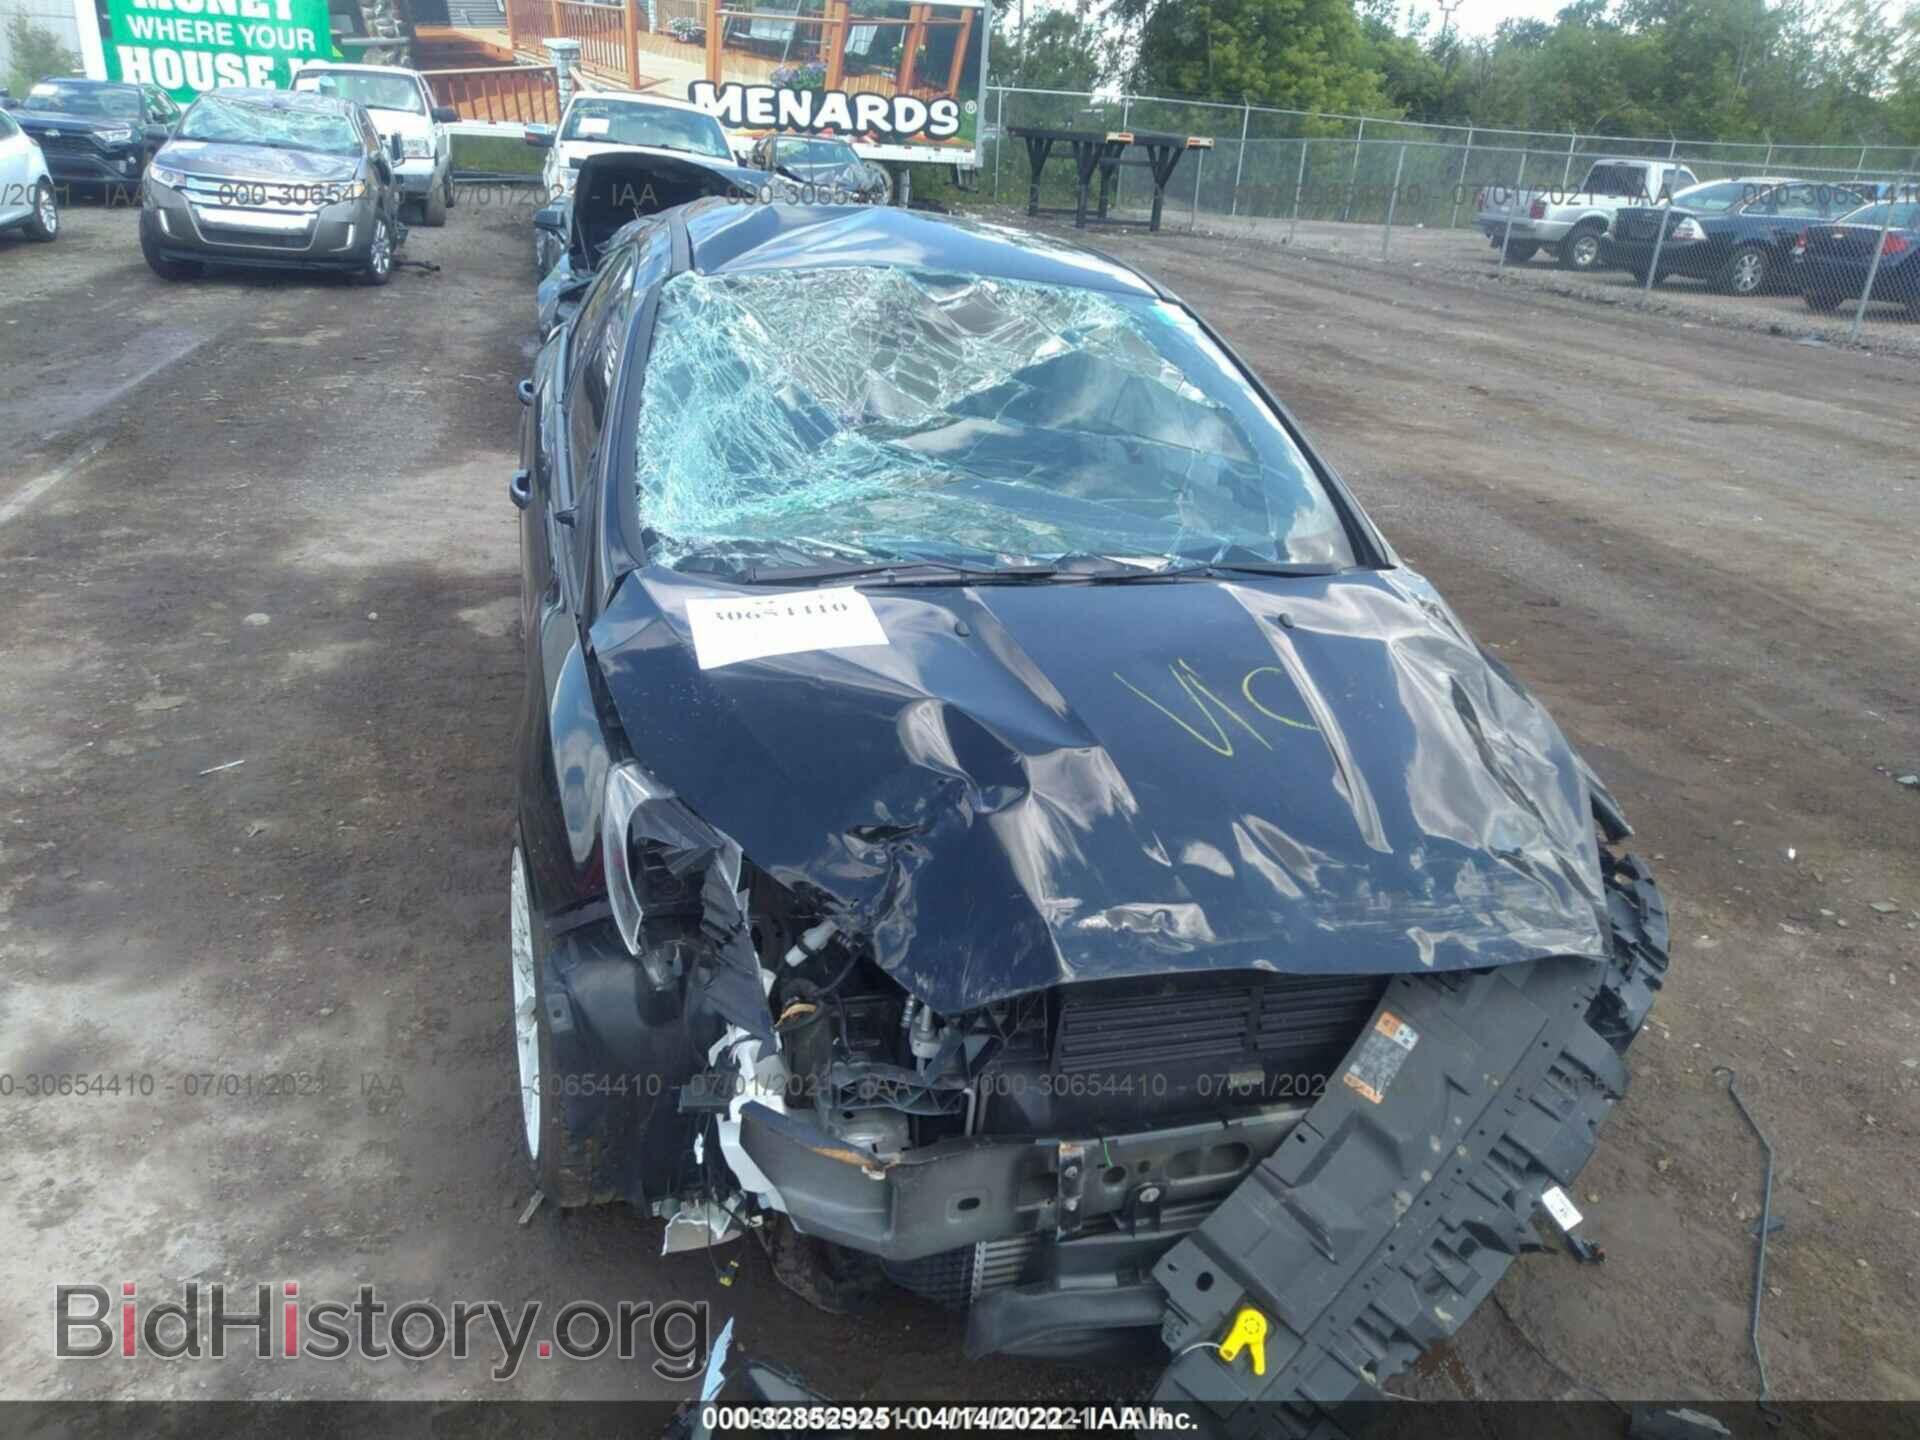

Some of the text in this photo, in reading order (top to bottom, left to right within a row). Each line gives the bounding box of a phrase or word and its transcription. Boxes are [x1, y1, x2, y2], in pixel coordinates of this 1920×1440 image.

[126, 15, 316, 52] WHERE YOUR
[116, 45, 277, 92] HOUSE
[690, 82, 961, 137] MENARDS
